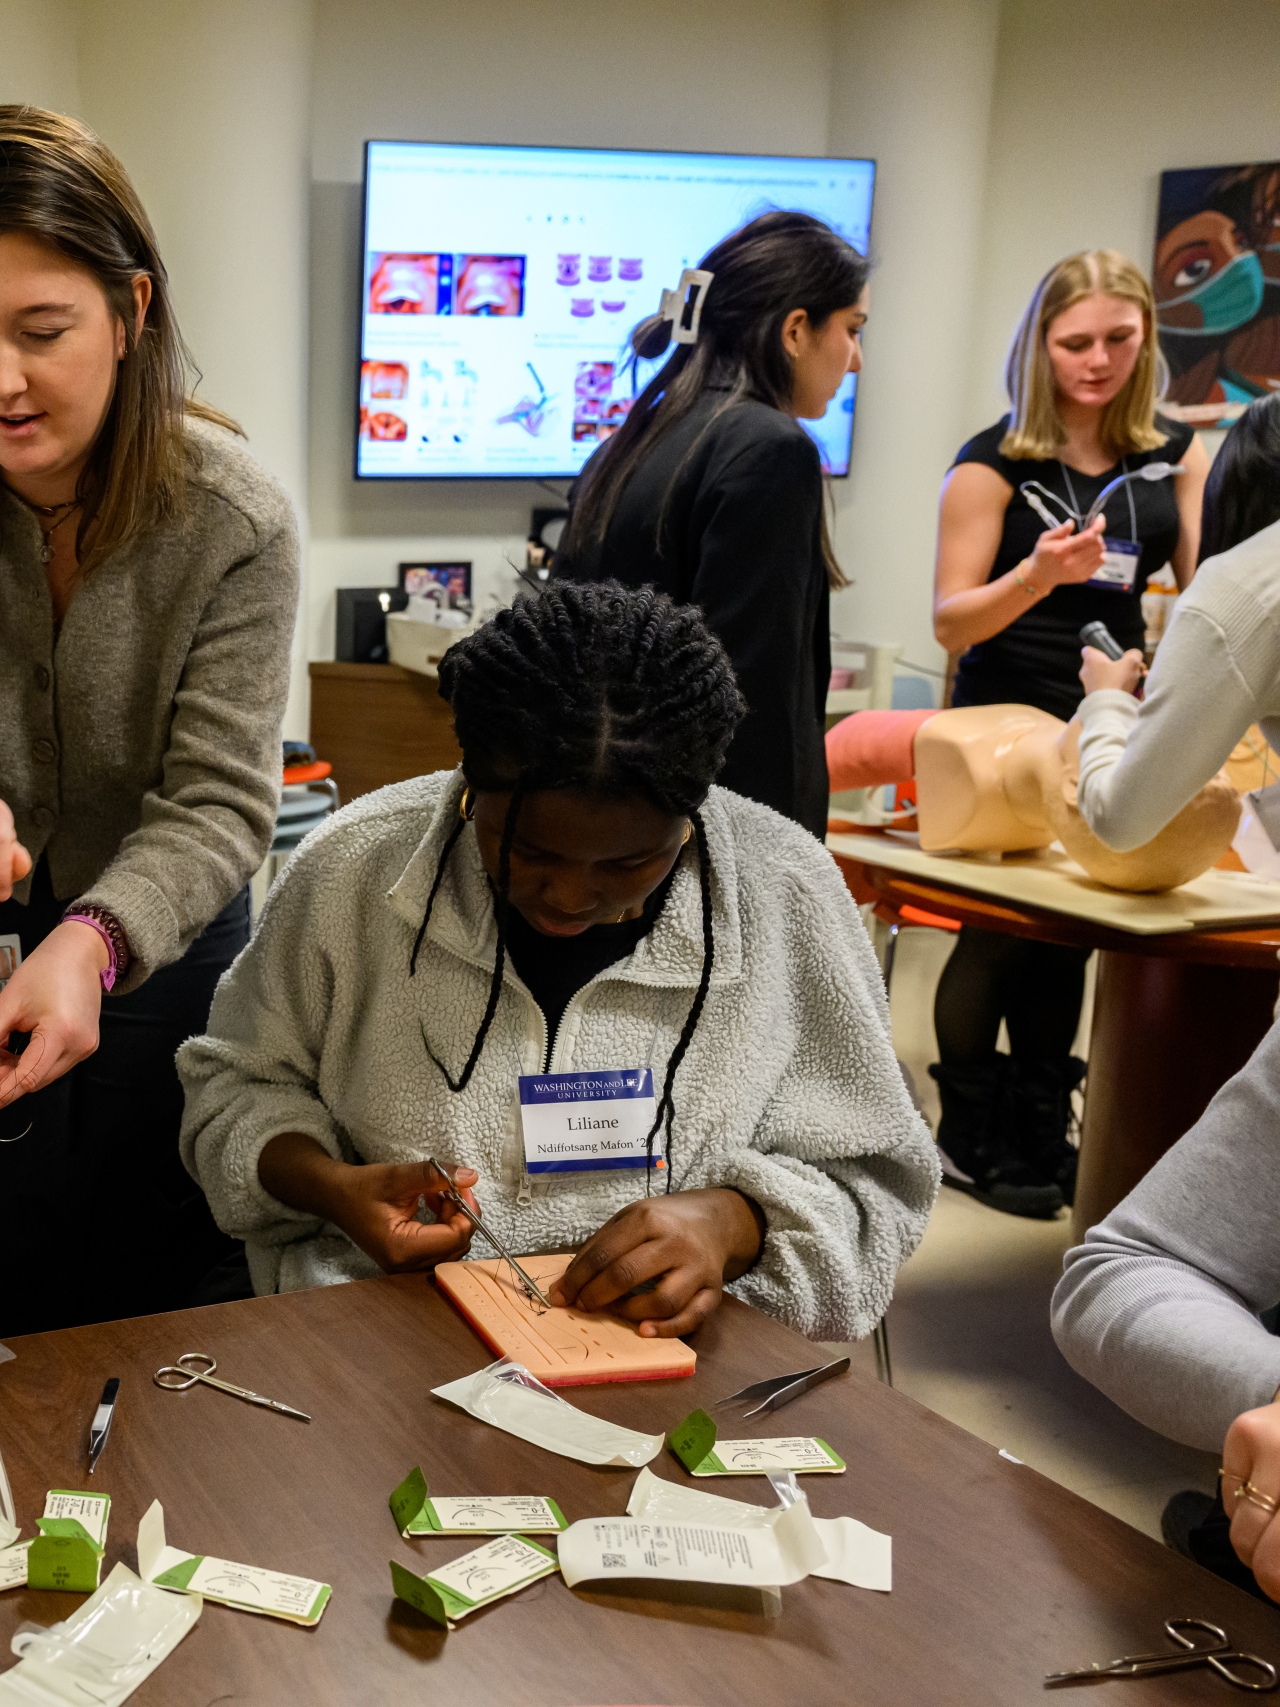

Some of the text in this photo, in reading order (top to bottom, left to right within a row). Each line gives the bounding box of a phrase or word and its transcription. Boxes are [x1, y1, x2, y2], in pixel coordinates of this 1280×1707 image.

[534, 1081, 603, 1093] WASHINGTON
[603, 1081, 620, 1089] AND
[557, 1089, 617, 1099] UNIVERSITY
[567, 1116, 620, 1131] Liliane
[537, 1141, 599, 1154] Ndiffotsang
[600, 1140, 634, 1150] Mafon
